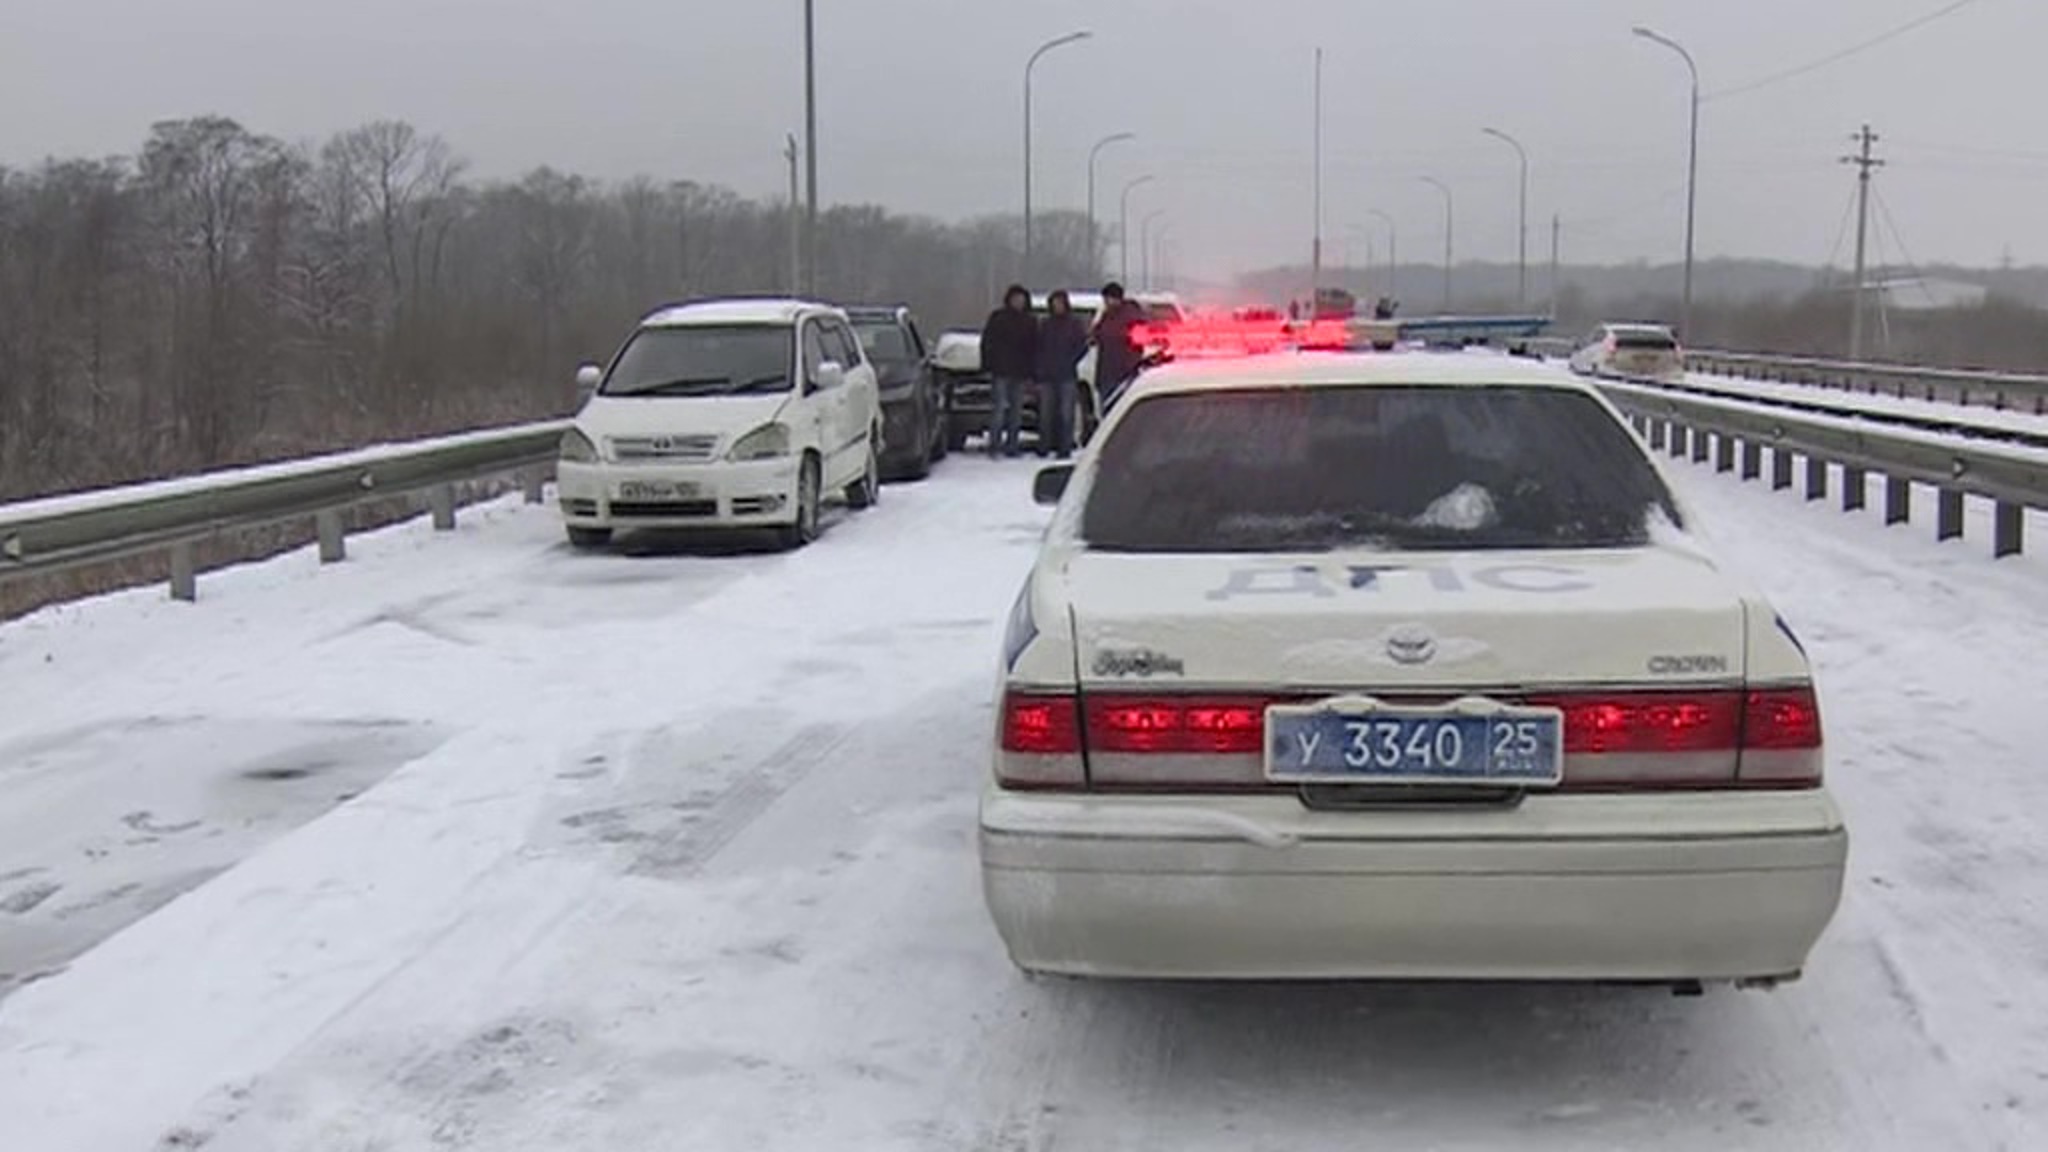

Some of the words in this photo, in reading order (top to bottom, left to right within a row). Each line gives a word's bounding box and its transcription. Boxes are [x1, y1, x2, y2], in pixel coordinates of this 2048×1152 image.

[1205, 564, 1597, 601] ДПС
[1344, 722, 1463, 768] 3340
[1493, 722, 1538, 755] 25
